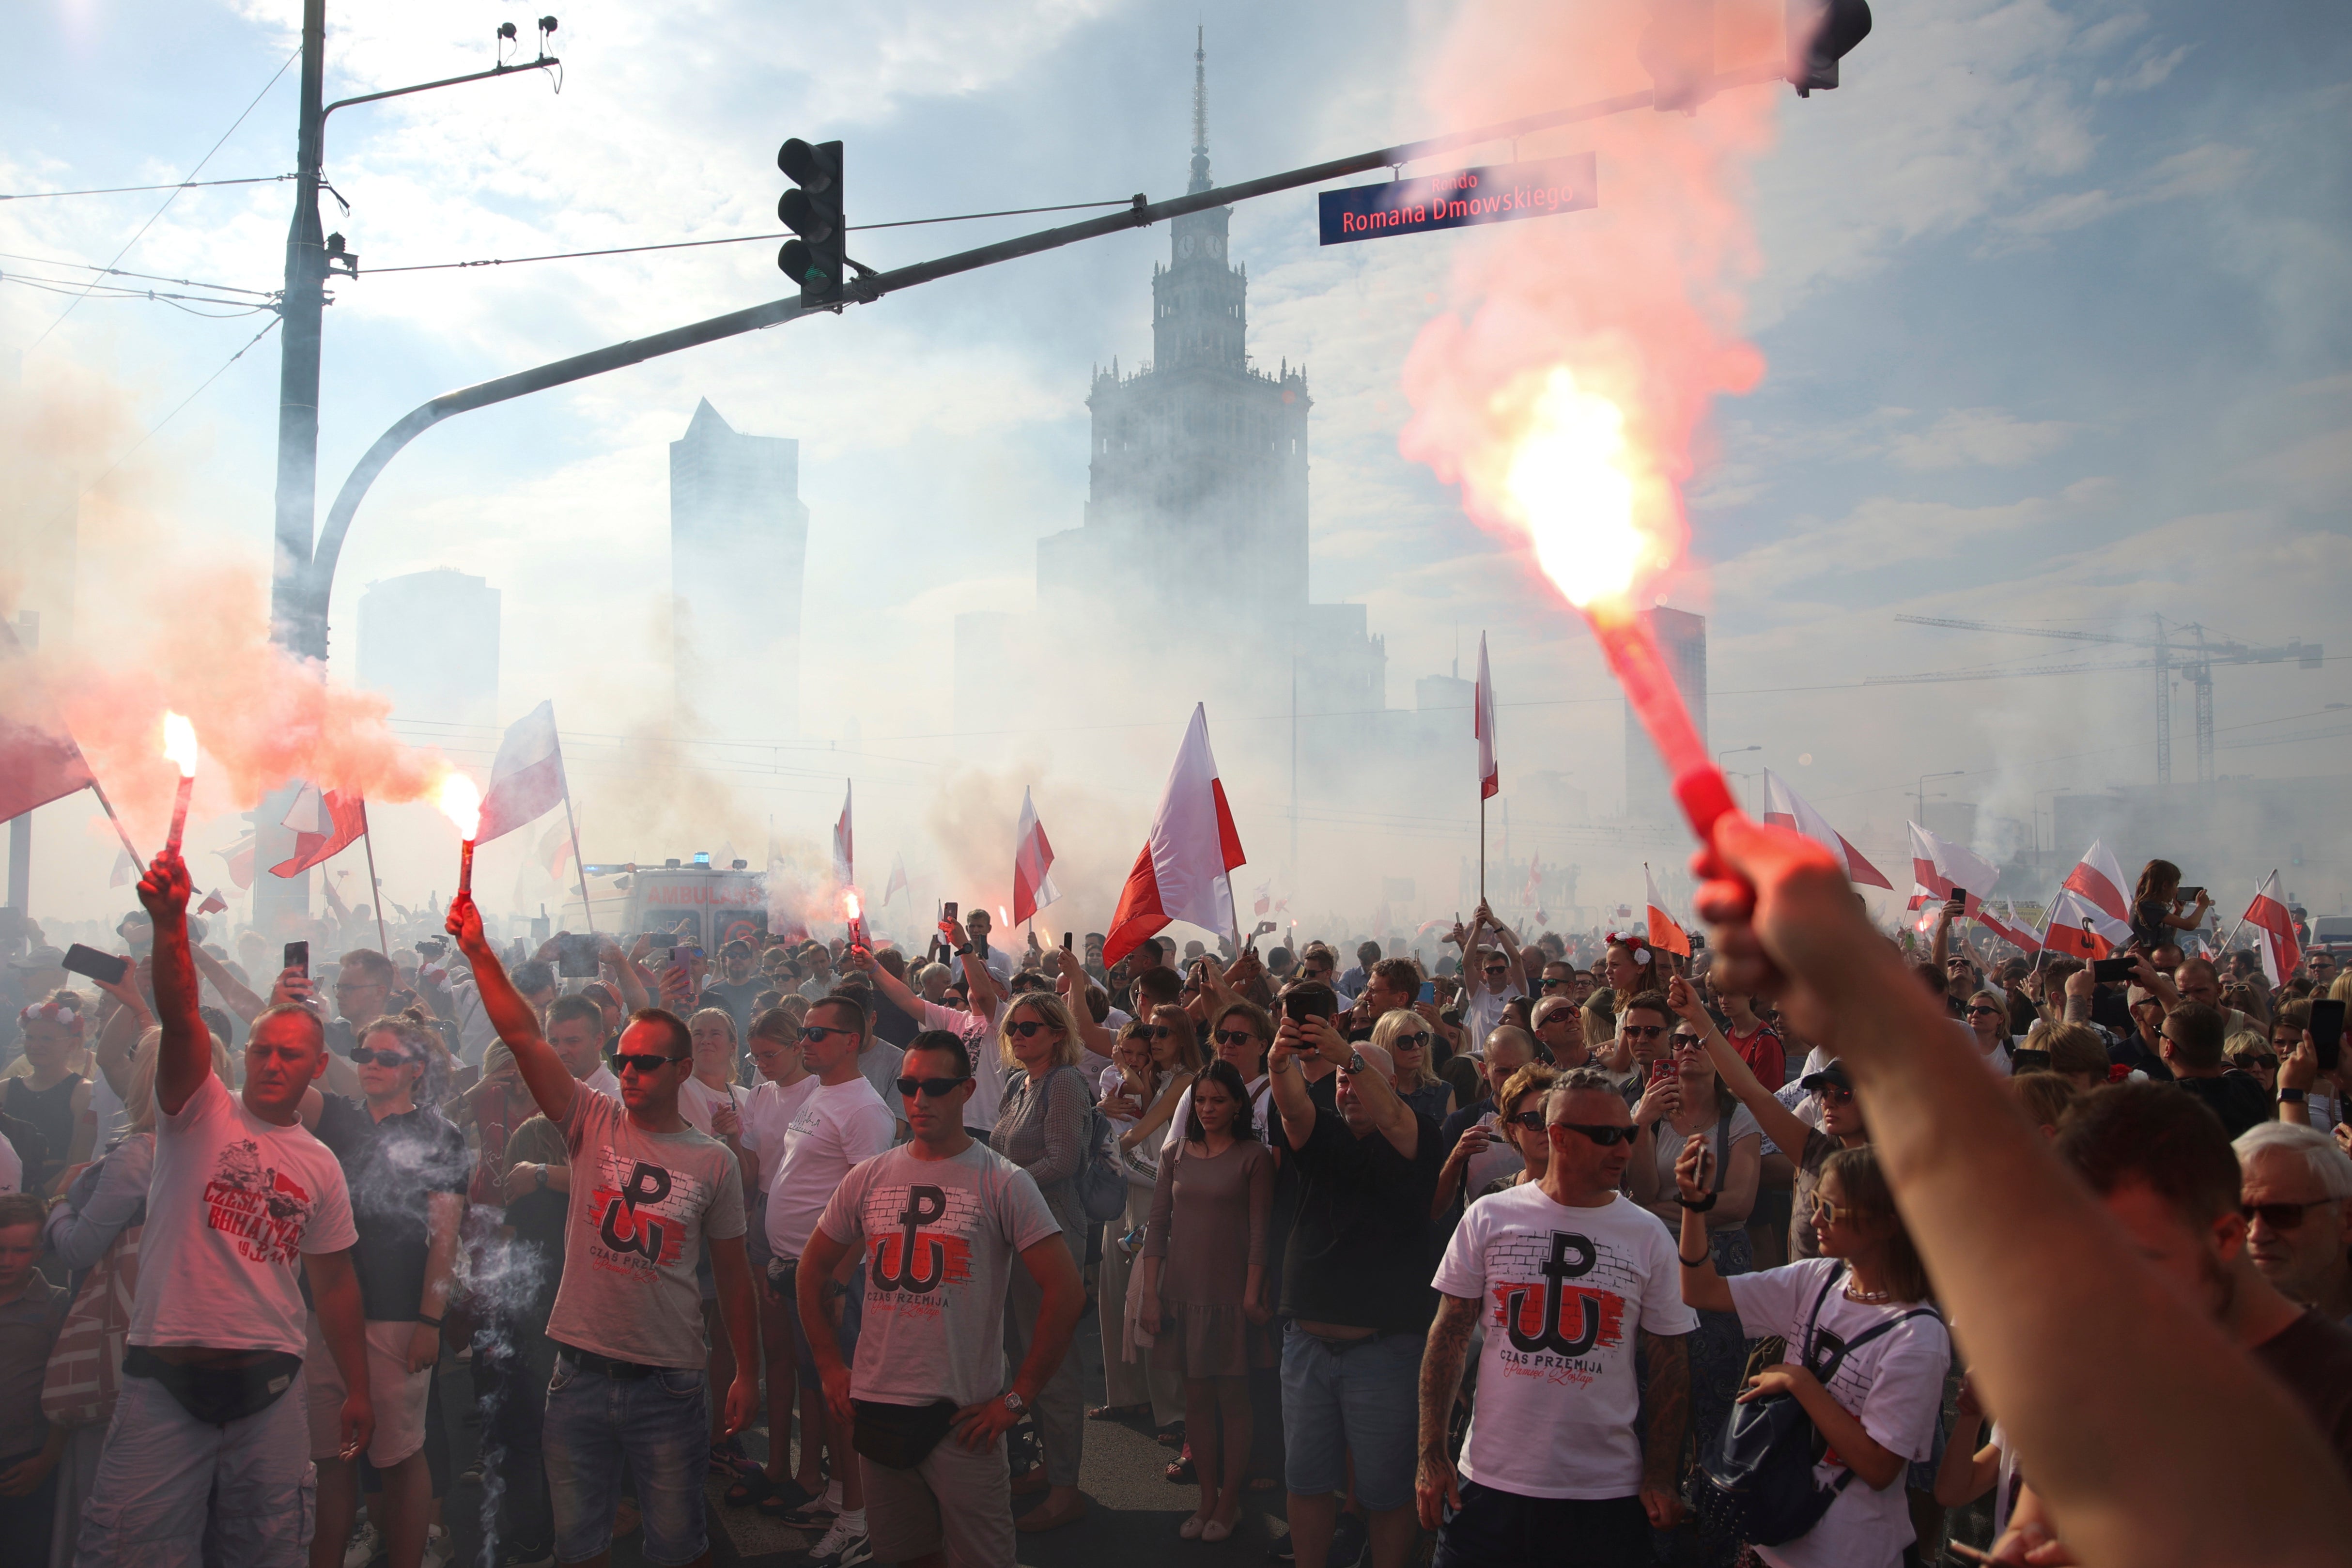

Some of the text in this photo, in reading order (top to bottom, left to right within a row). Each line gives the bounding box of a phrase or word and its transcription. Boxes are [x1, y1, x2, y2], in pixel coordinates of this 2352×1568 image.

[1432, 171, 1478, 192] Rondo
[1343, 185, 1573, 233] Romana Dmowskiego
[647, 885, 760, 905] AMBULANS
[590, 1246, 619, 1262] CZAS
[867, 1292, 948, 1307] CZAS RZEMIJA
[899, 1302, 940, 1321] Zostaje
[1501, 1350, 1602, 1374] CZAS PRZEMIJA
[1503, 1360, 1593, 1390] Pamięć Zostaje
